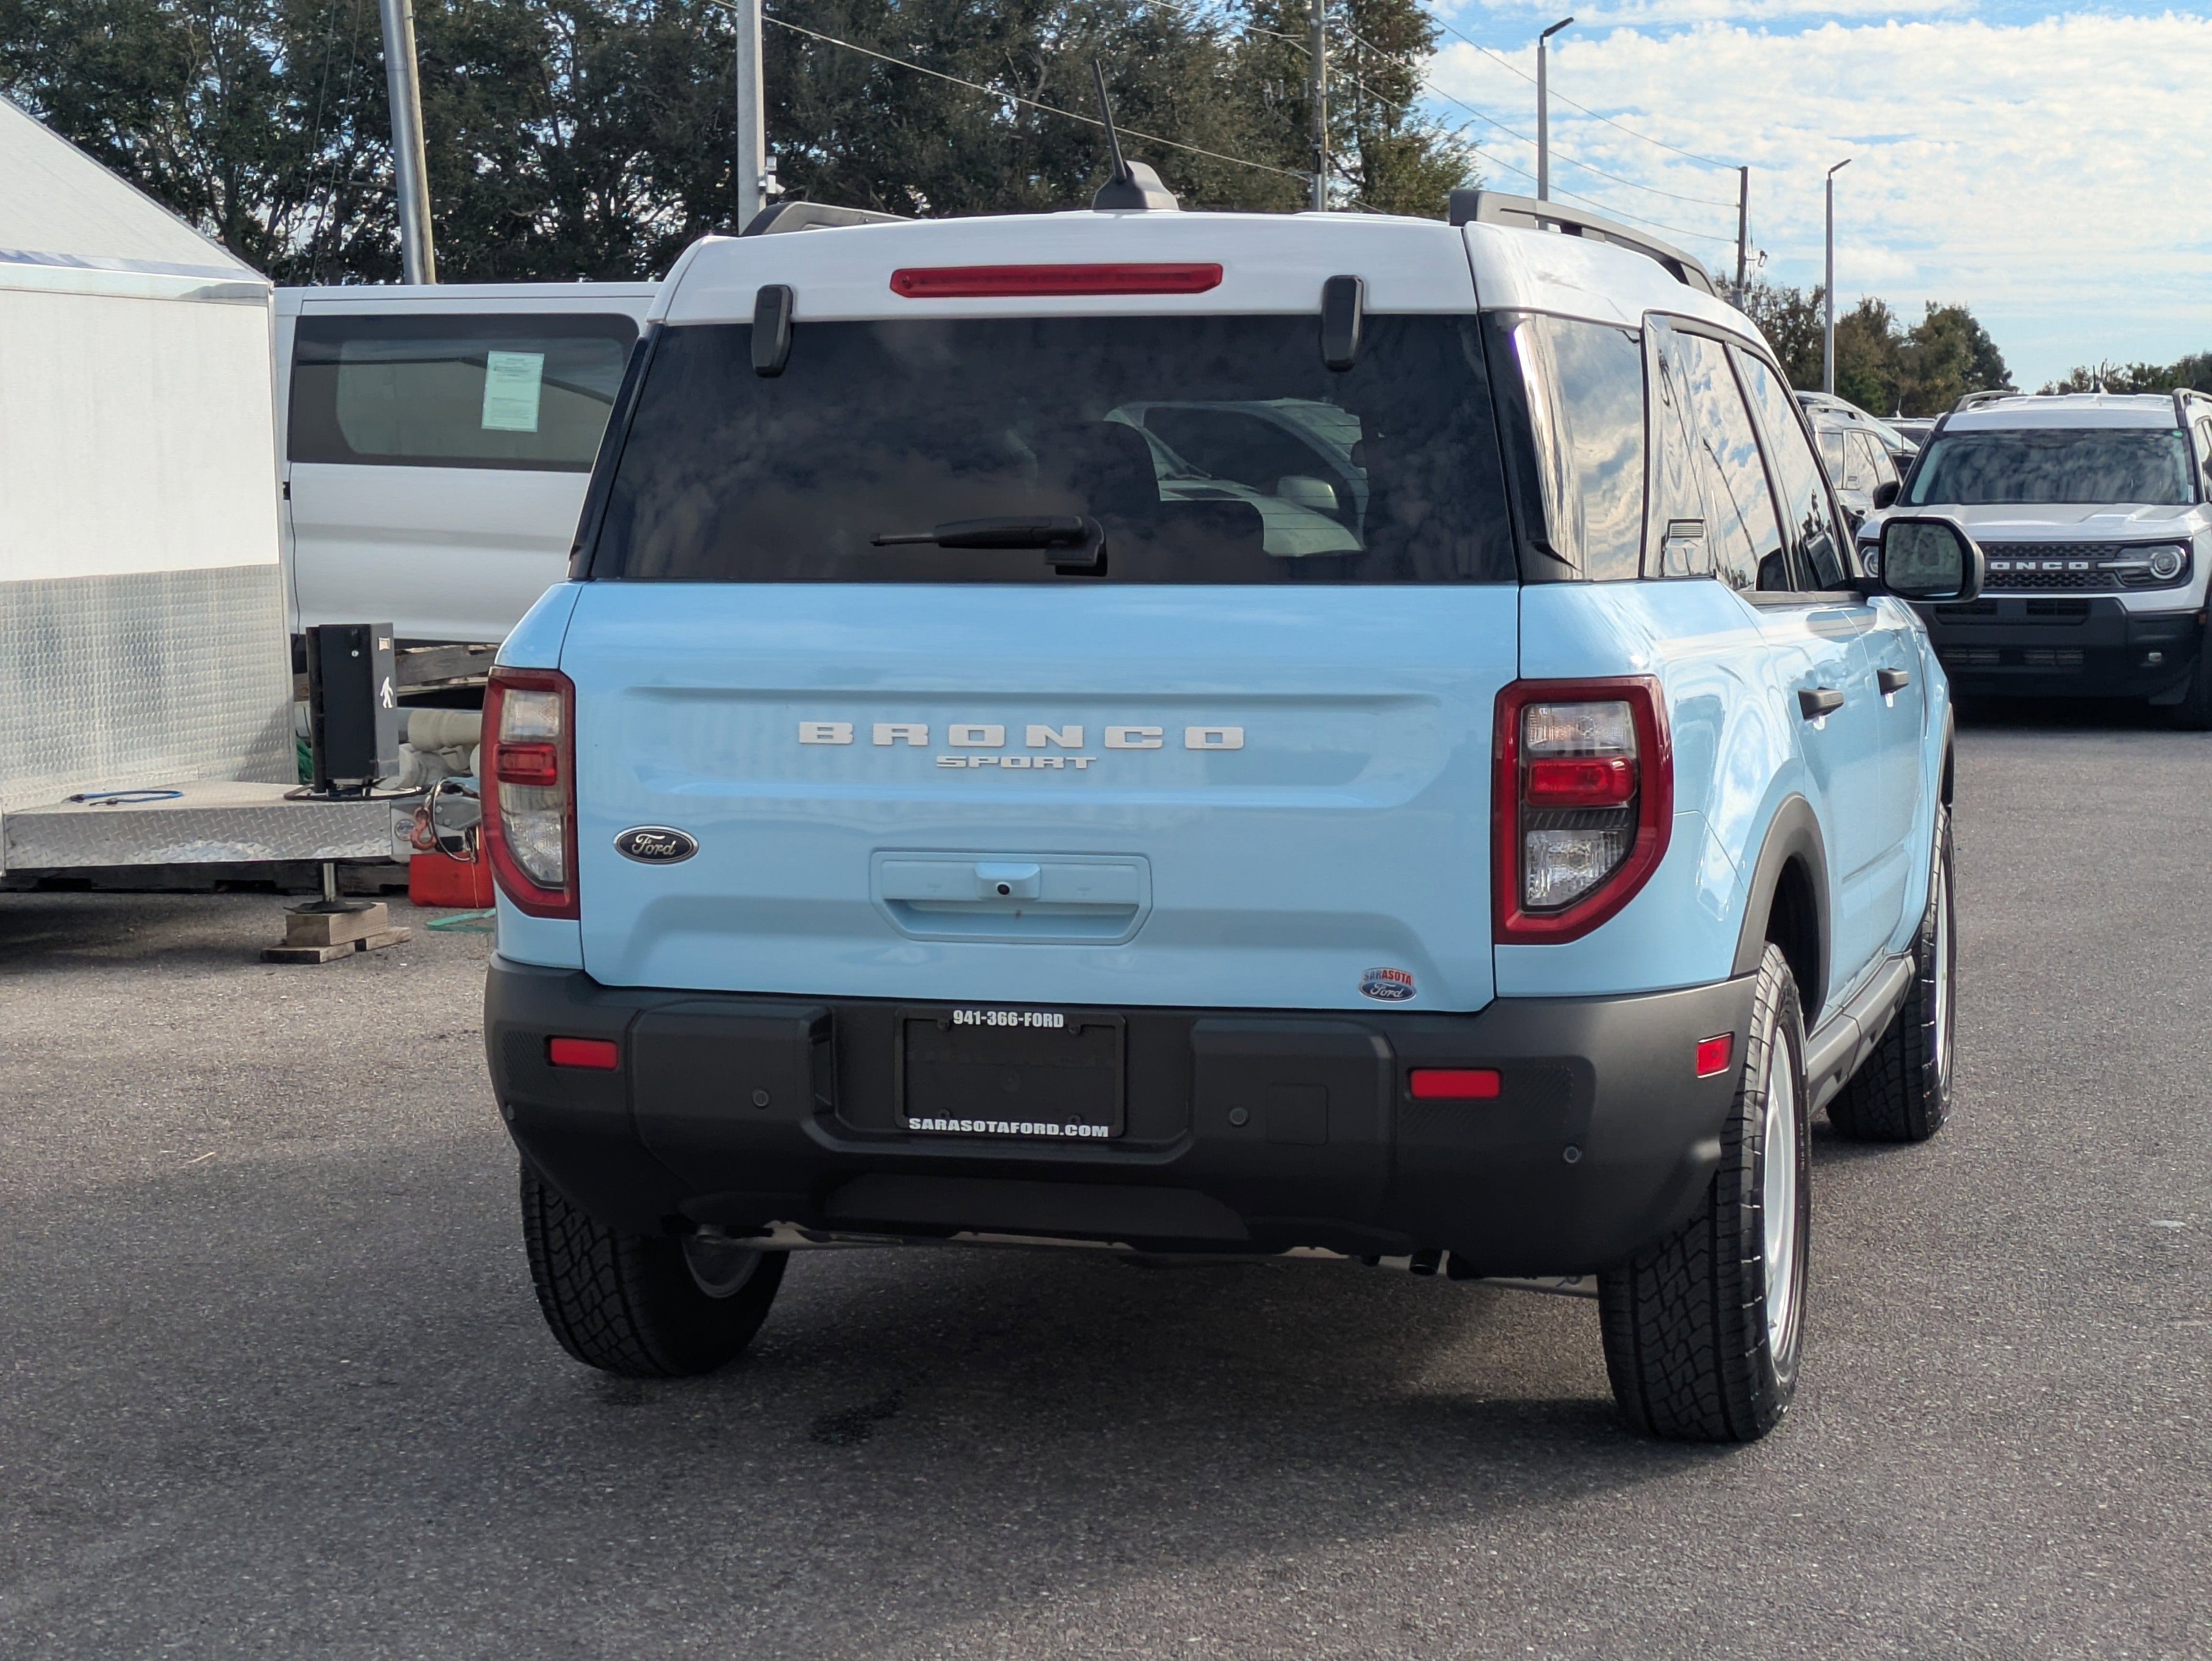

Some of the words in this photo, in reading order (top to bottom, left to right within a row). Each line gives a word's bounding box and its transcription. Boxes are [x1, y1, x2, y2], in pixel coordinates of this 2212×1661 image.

[1990, 561, 2089, 570] ONCO
[798, 721, 1244, 749] BRONCO
[936, 755, 1097, 769] SPORT
[631, 833, 677, 855] Ford
[1363, 969, 1412, 986] SARASOTA
[1370, 982, 1405, 998] Ford
[953, 1010, 1064, 1028] 941-366-FORD
[908, 1118, 1109, 1138] SARASOTAFORD.COM
